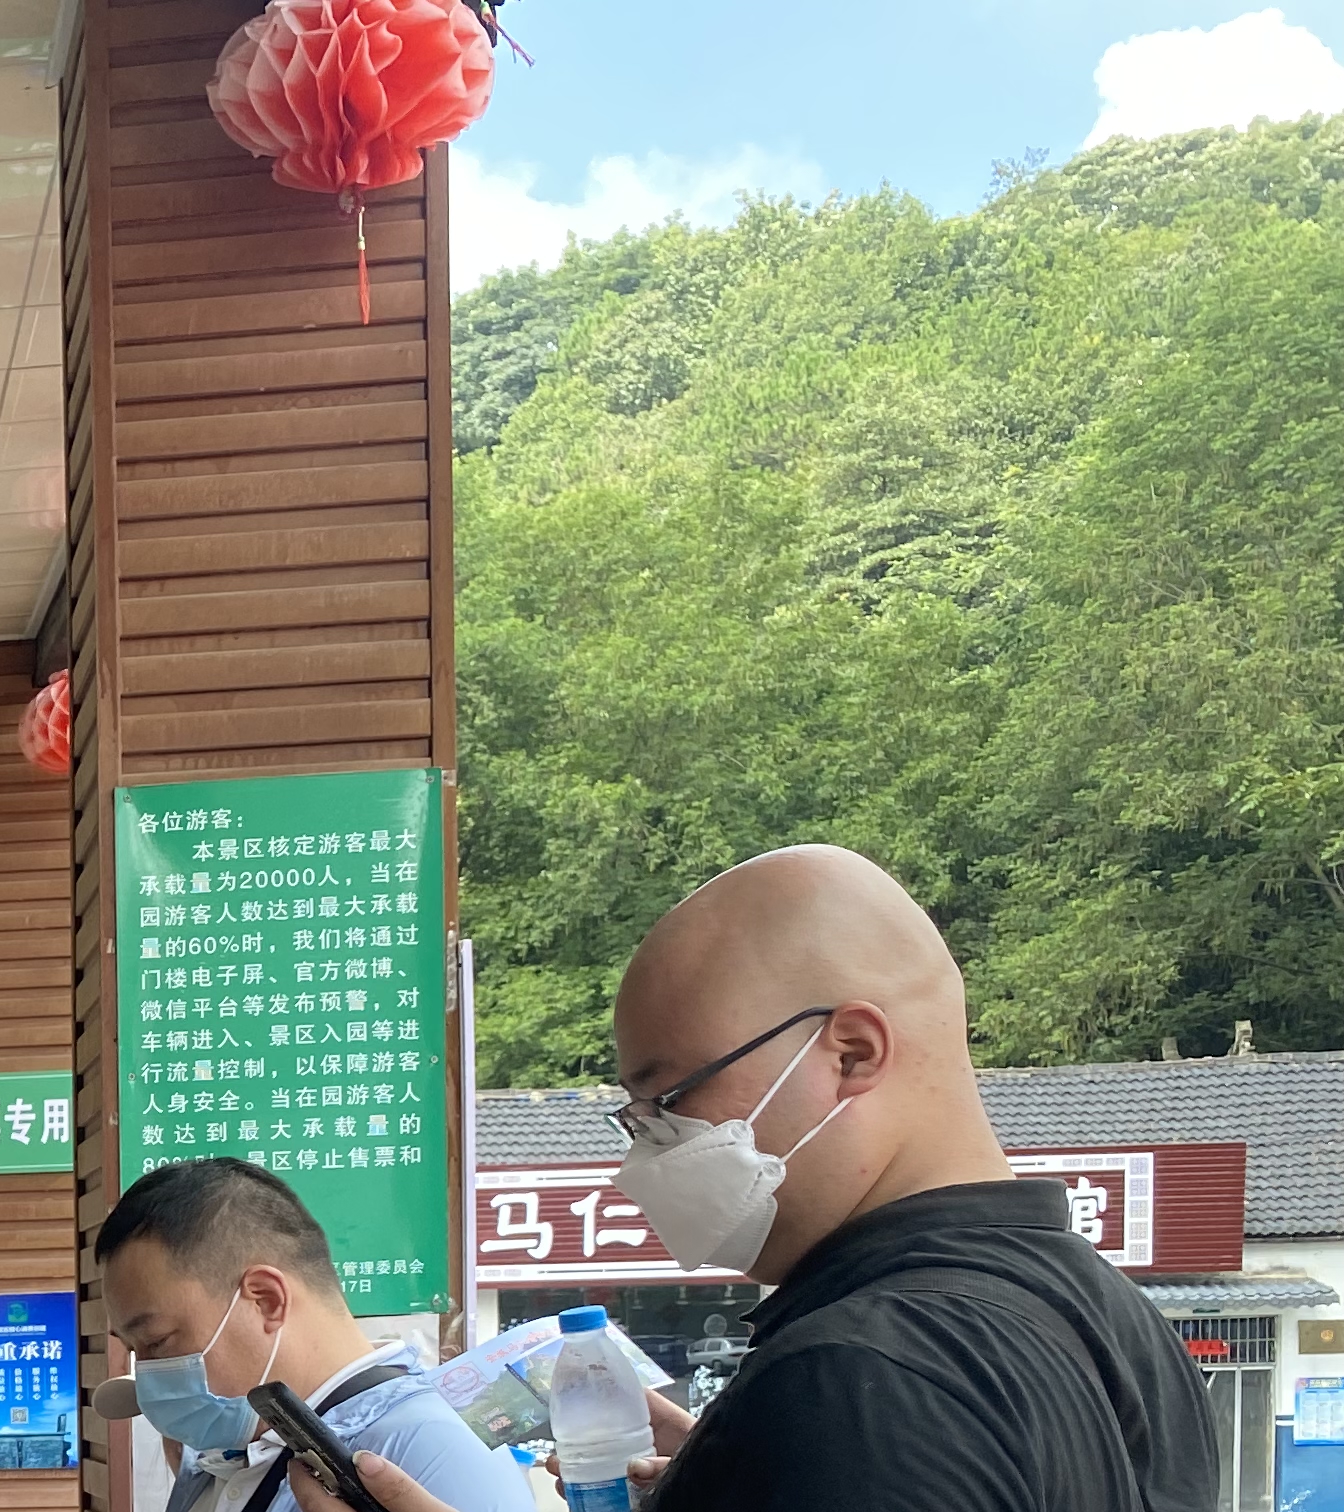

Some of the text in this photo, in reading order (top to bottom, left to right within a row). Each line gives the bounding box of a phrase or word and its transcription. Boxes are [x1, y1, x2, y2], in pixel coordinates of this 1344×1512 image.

[138, 809, 244, 834] 各位游客：
[192, 829, 417, 862] 本景区核定游客最大
[139, 860, 418, 897] 承载量为20000人，当在
[140, 892, 419, 928] 园游客人数达到最大承载
[140, 924, 420, 960] 量的60%时，我们将通过
[141, 957, 411, 991] 门楼电子屏、官方微博、
[141, 987, 420, 1023] 微信平台等发布预警，对
[141, 1019, 420, 1053] 车辆进入、景区入园等进
[141, 1050, 420, 1084] 行流量控制，以保障游客
[143, 1082, 421, 1115] 人身安全。当在园游客人
[142, 1113, 421, 1146] 数达到最大承载量的
[479, 1190, 649, 1262] 马仁
